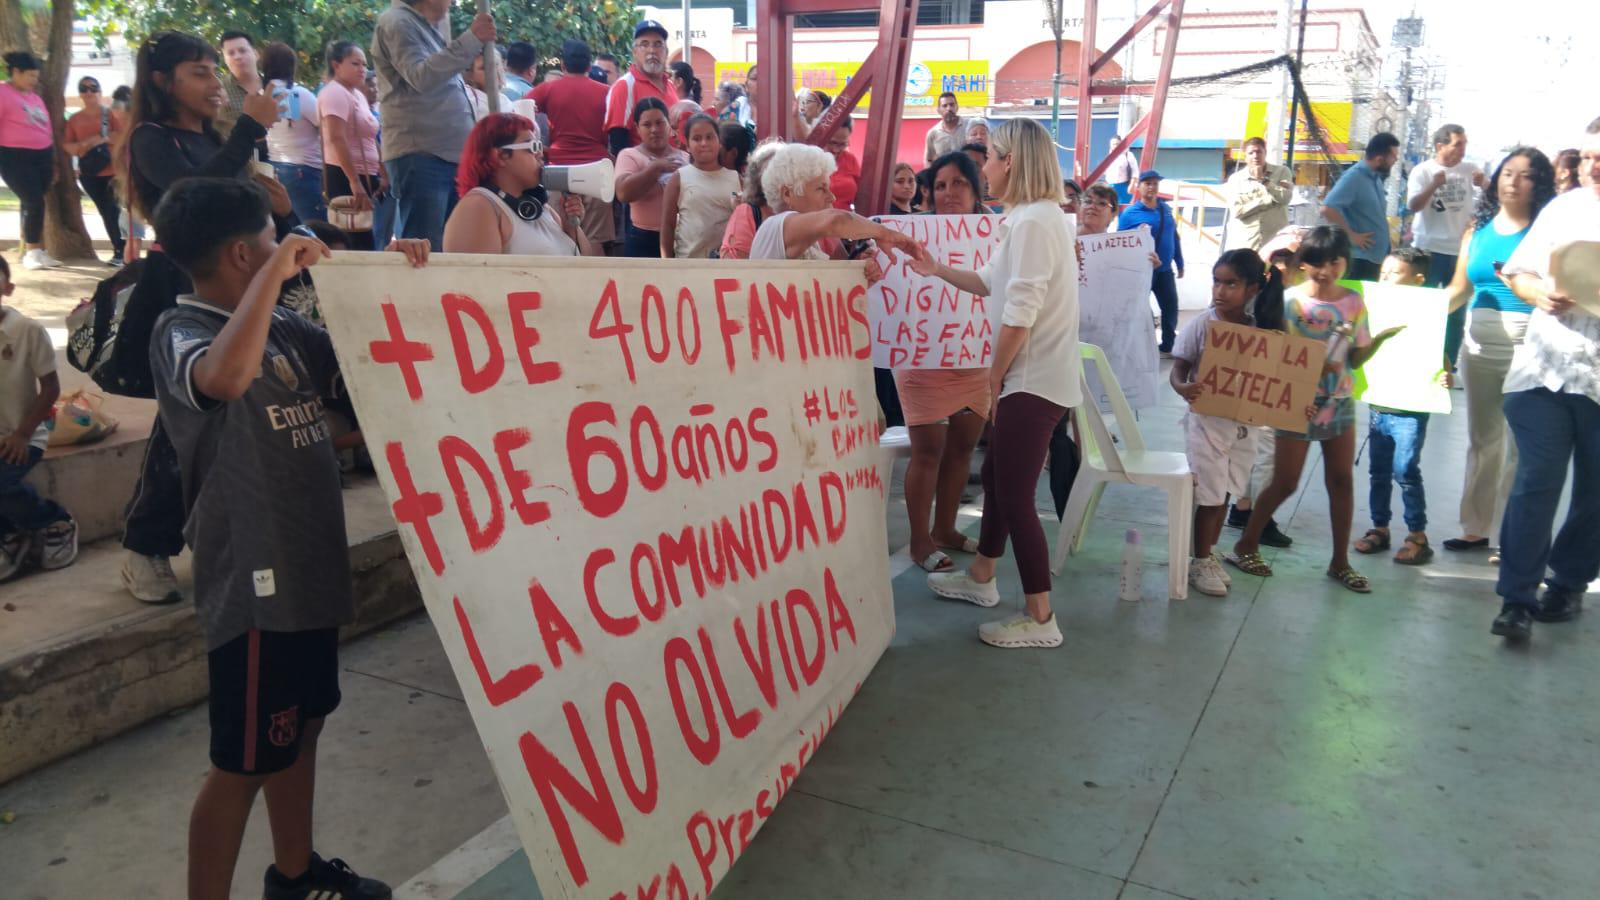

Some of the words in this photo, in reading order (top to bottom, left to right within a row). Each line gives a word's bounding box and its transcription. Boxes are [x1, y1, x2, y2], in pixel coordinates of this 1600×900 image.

[676, 30, 707, 40] PURTA
[1105, 236, 1142, 250] AZTECA
[440, 291, 563, 395] DE
[588, 279, 702, 385] 400
[877, 318, 929, 344] LAS
[1211, 327, 1268, 359] VIVA
[1282, 344, 1309, 369] LA
[889, 345, 930, 369] DE
[1202, 364, 1292, 412] AZTECA
[437, 427, 551, 554] DE
[453, 578, 584, 708] LA
[582, 470, 847, 638] COMUNIDAD
[517, 681, 659, 888] NO
[663, 566, 857, 767] OLVIDA
